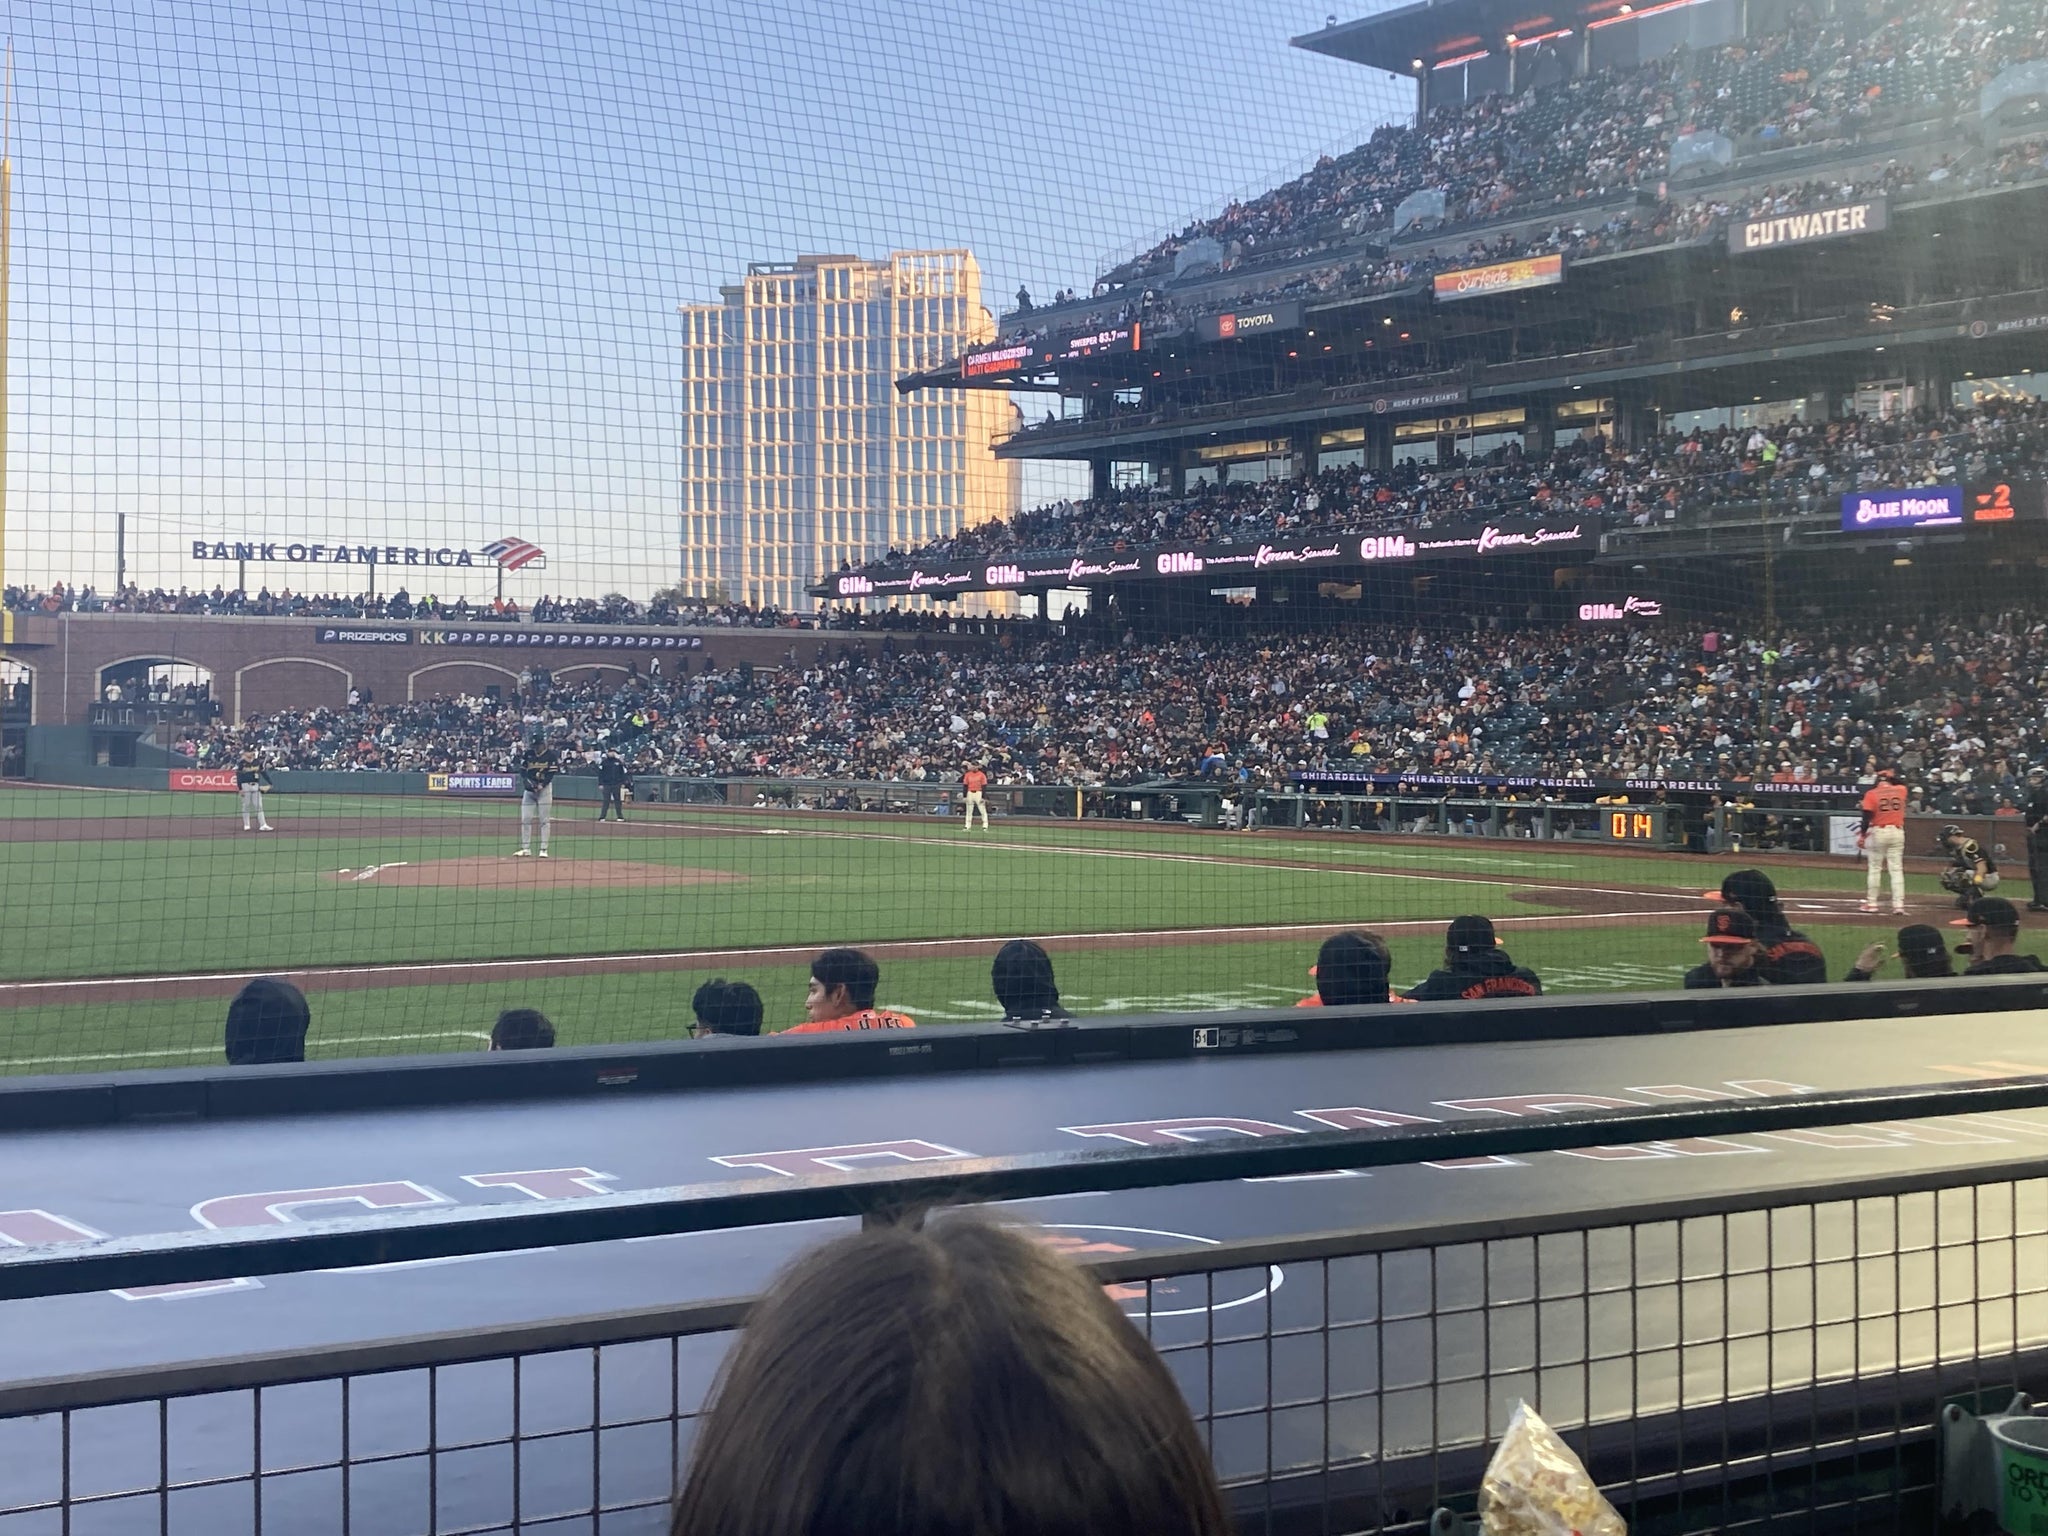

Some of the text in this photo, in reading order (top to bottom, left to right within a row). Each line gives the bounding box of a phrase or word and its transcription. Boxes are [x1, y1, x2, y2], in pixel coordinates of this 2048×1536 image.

[1745, 204, 1866, 247] CUTWATER
[1237, 313, 1274, 328] TOYOTA
[1994, 484, 2011, 506] 2
[1477, 527, 1534, 553] Korean
[192, 541, 473, 566] BANK OF AMERICA
[1254, 544, 1301, 568] Korean
[339, 631, 407, 642] PRIZEPICKS
[431, 777, 513, 789] THE SPORTS LEADER
[1880, 796, 1901, 812] 26
